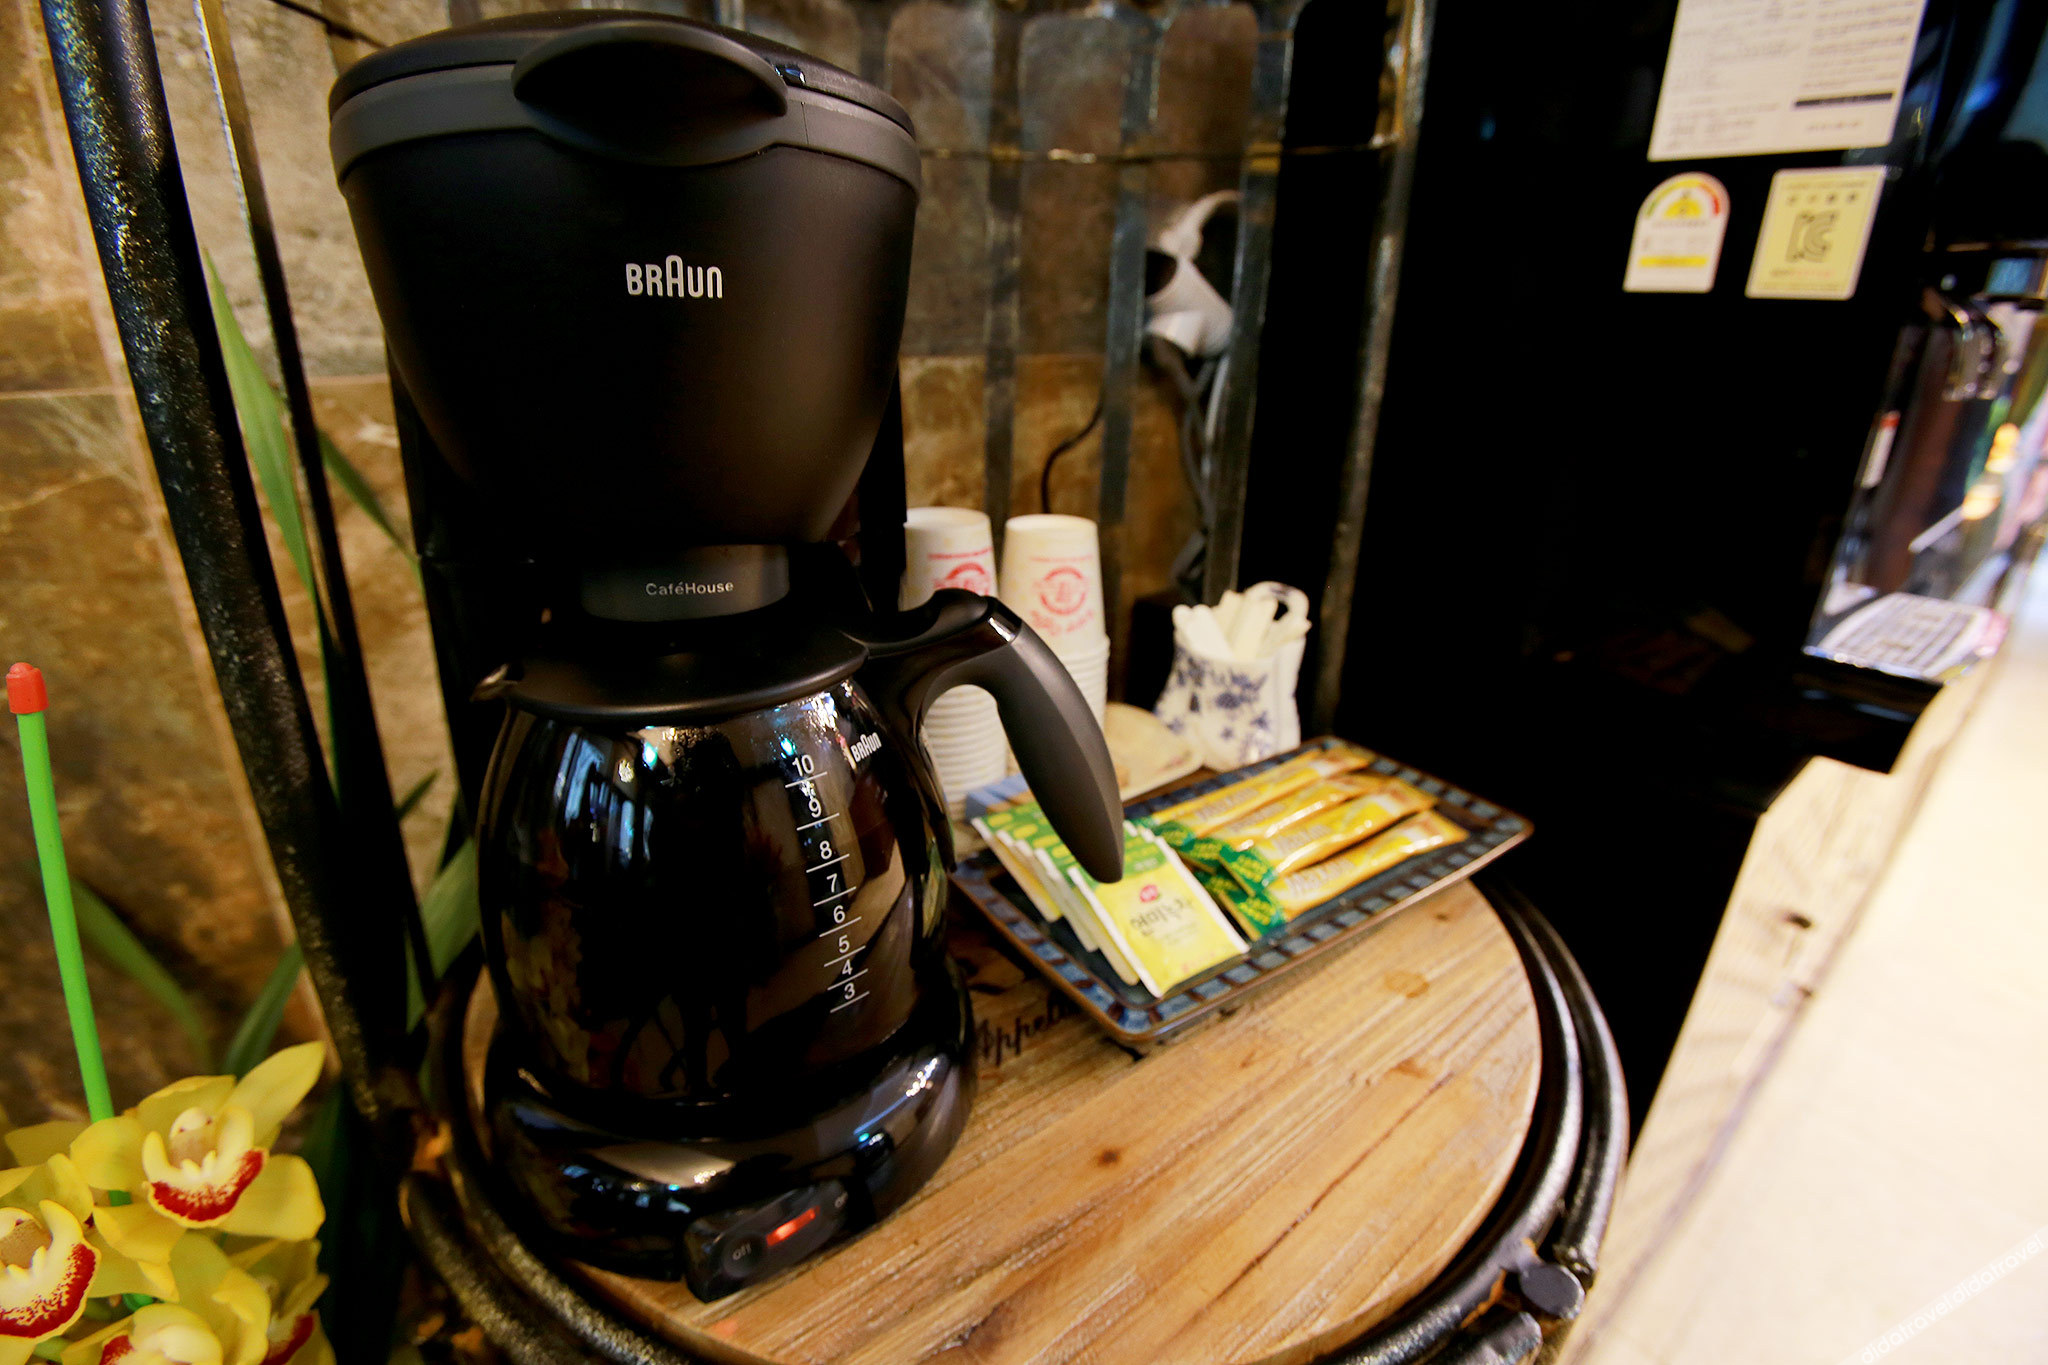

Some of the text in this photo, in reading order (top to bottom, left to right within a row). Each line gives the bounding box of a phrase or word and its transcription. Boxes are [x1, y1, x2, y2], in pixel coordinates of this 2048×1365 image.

[625, 254, 723, 299] BRAUN
[645, 581, 734, 596] CaféHouse
[792, 754, 815, 777] 10
[808, 798, 822, 818] 9
[819, 840, 833, 860] 8
[826, 873, 838, 893] 7
[833, 905, 846, 924] 6
[838, 934, 850, 954] 5
[842, 959, 853, 975] 4
[844, 982, 856, 1000] 3
